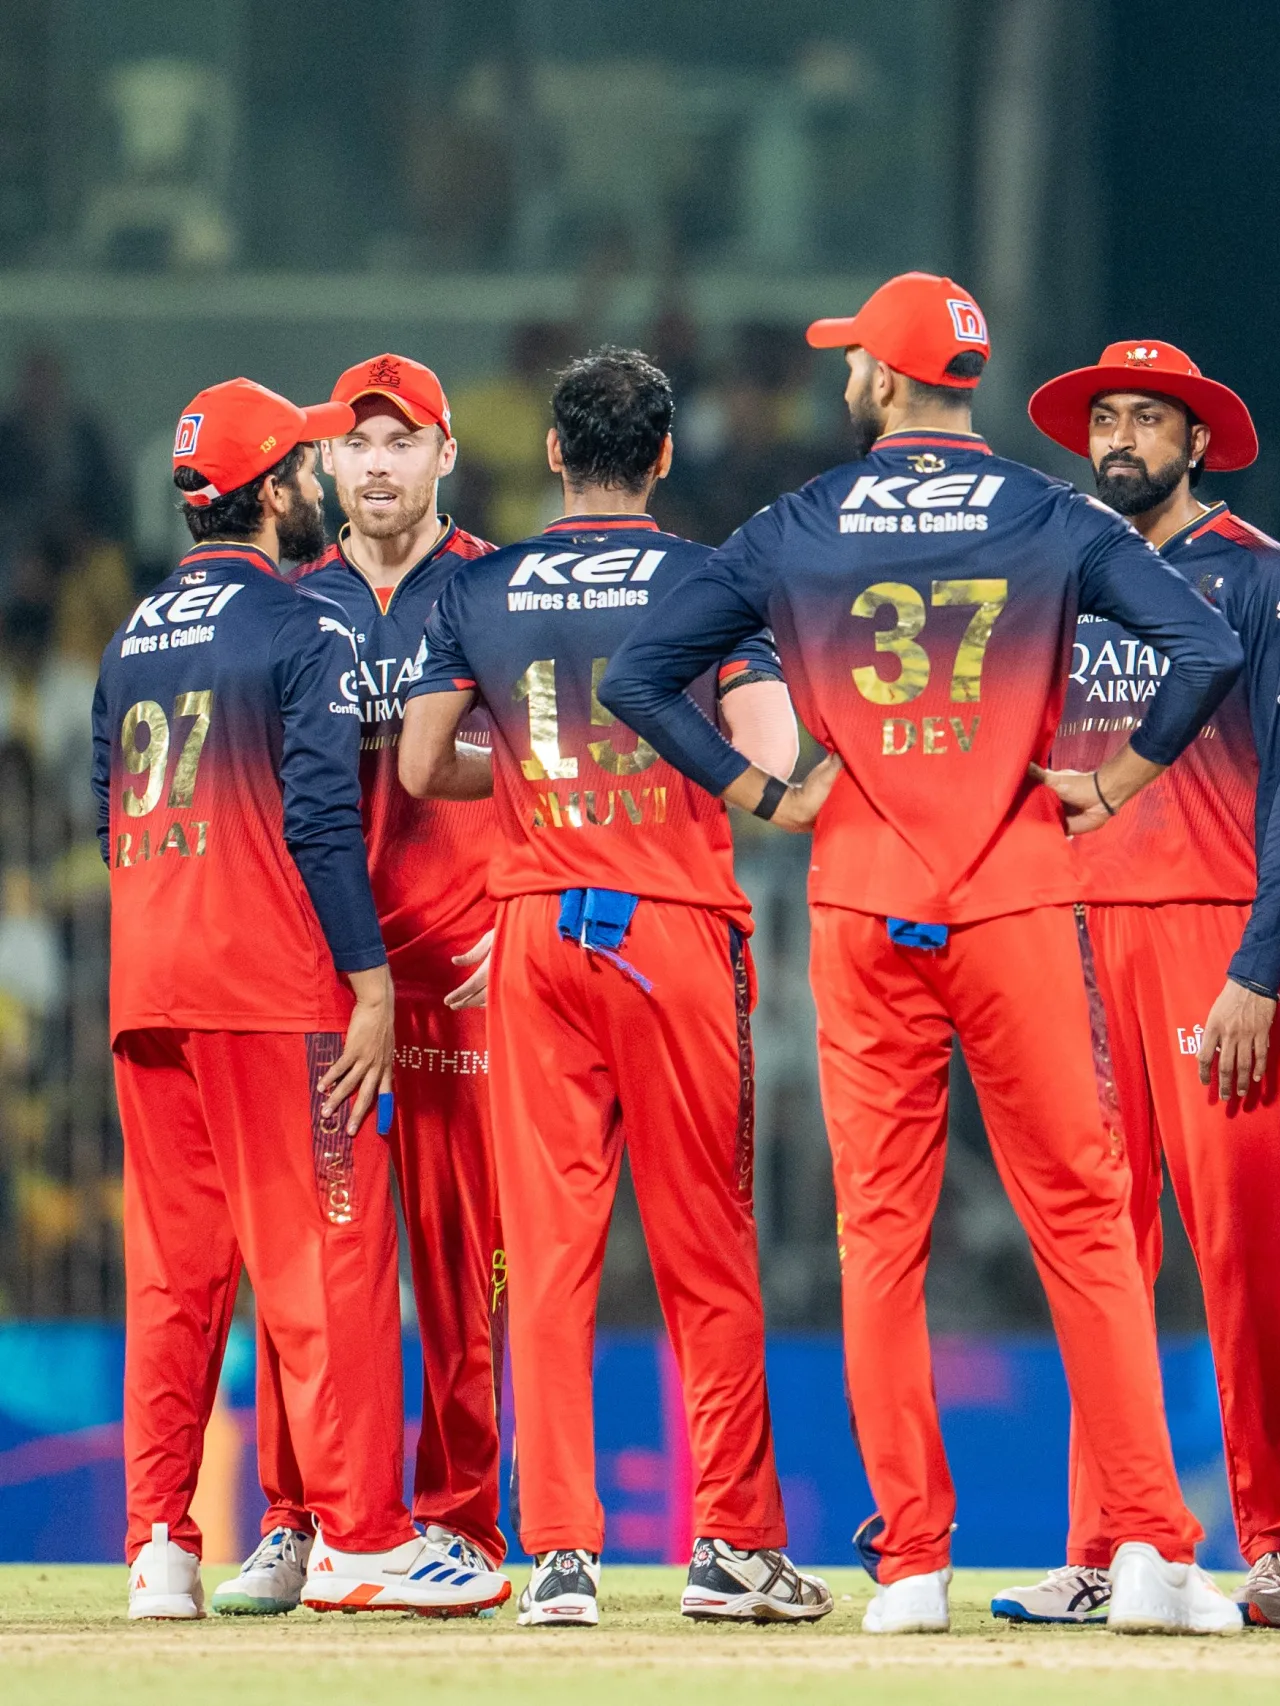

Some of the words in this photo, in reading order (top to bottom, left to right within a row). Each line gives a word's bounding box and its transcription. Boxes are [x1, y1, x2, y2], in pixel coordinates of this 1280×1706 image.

[260, 435, 277, 454] 139
[840, 474, 1006, 509] KEI
[839, 513, 899, 534] Wires
[901, 514, 916, 533] &
[919, 511, 988, 533] Cables
[508, 549, 667, 587] KEI
[125, 583, 245, 634] KEI
[508, 591, 564, 612] Wires
[566, 592, 581, 610] &
[583, 587, 649, 609] Cables
[121, 635, 158, 659] Wires
[158, 632, 169, 651] &
[170, 624, 215, 648] Cables
[850, 578, 1008, 705] 37
[358, 657, 415, 696] ATA
[1085, 679, 1161, 703] AIRWA
[512, 656, 661, 781] 15
[882, 715, 981, 756] DEV
[120, 689, 213, 818] 97
[394, 1045, 489, 1075] NOTHIN
